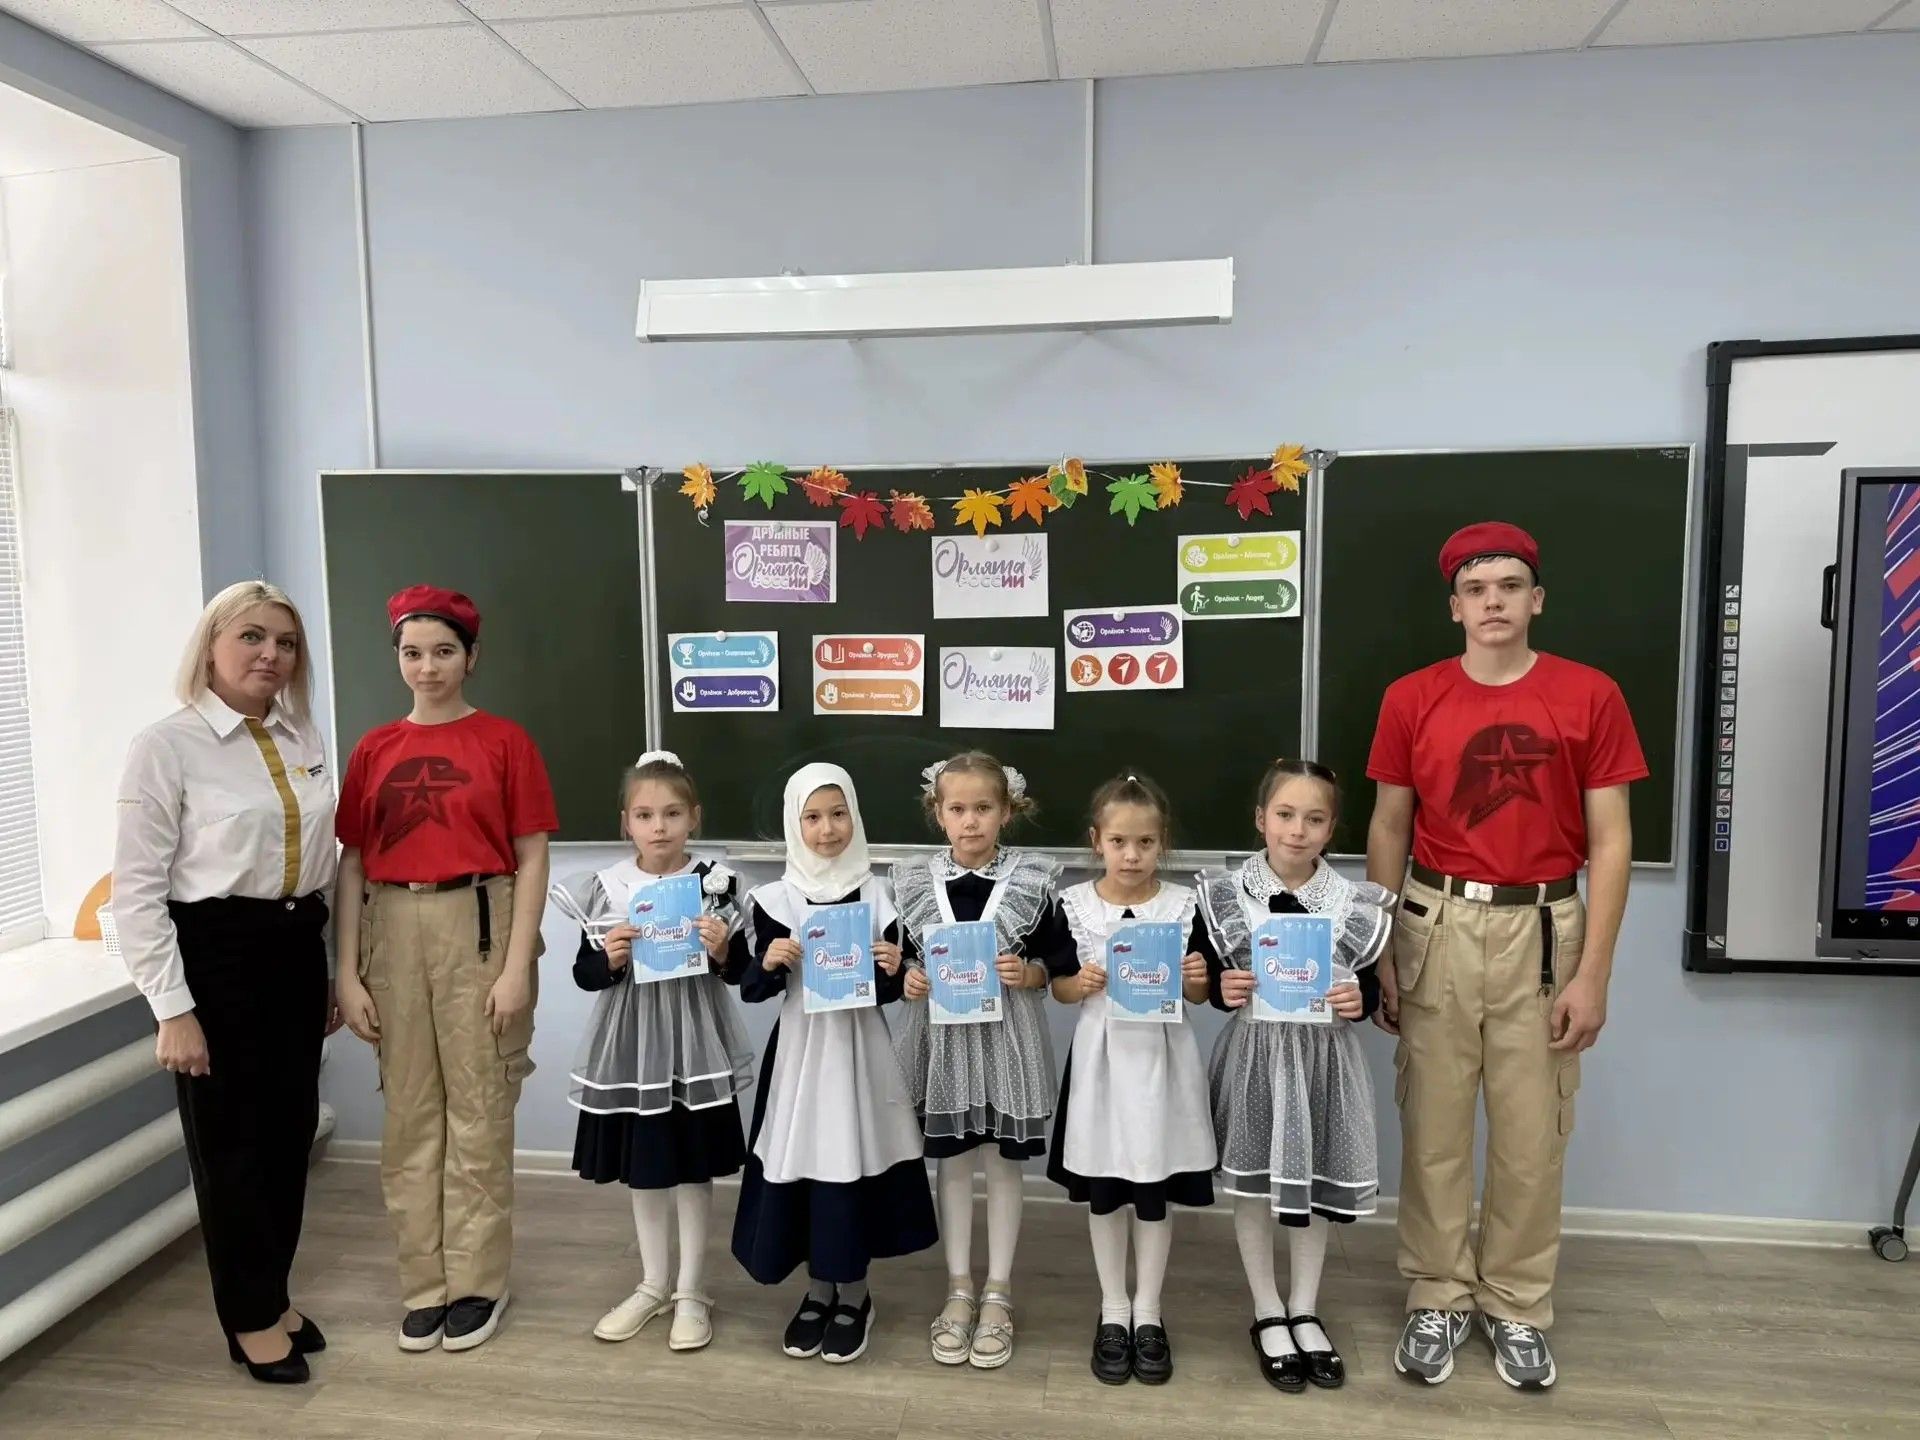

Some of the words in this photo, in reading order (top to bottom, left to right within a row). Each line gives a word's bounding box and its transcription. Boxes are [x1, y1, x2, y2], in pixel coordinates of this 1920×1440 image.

[734, 543, 809, 585] Орлята
[760, 544, 801, 557] РЕБЯТА
[935, 538, 1025, 584] Орлята
[943, 652, 1033, 694] Орлята
